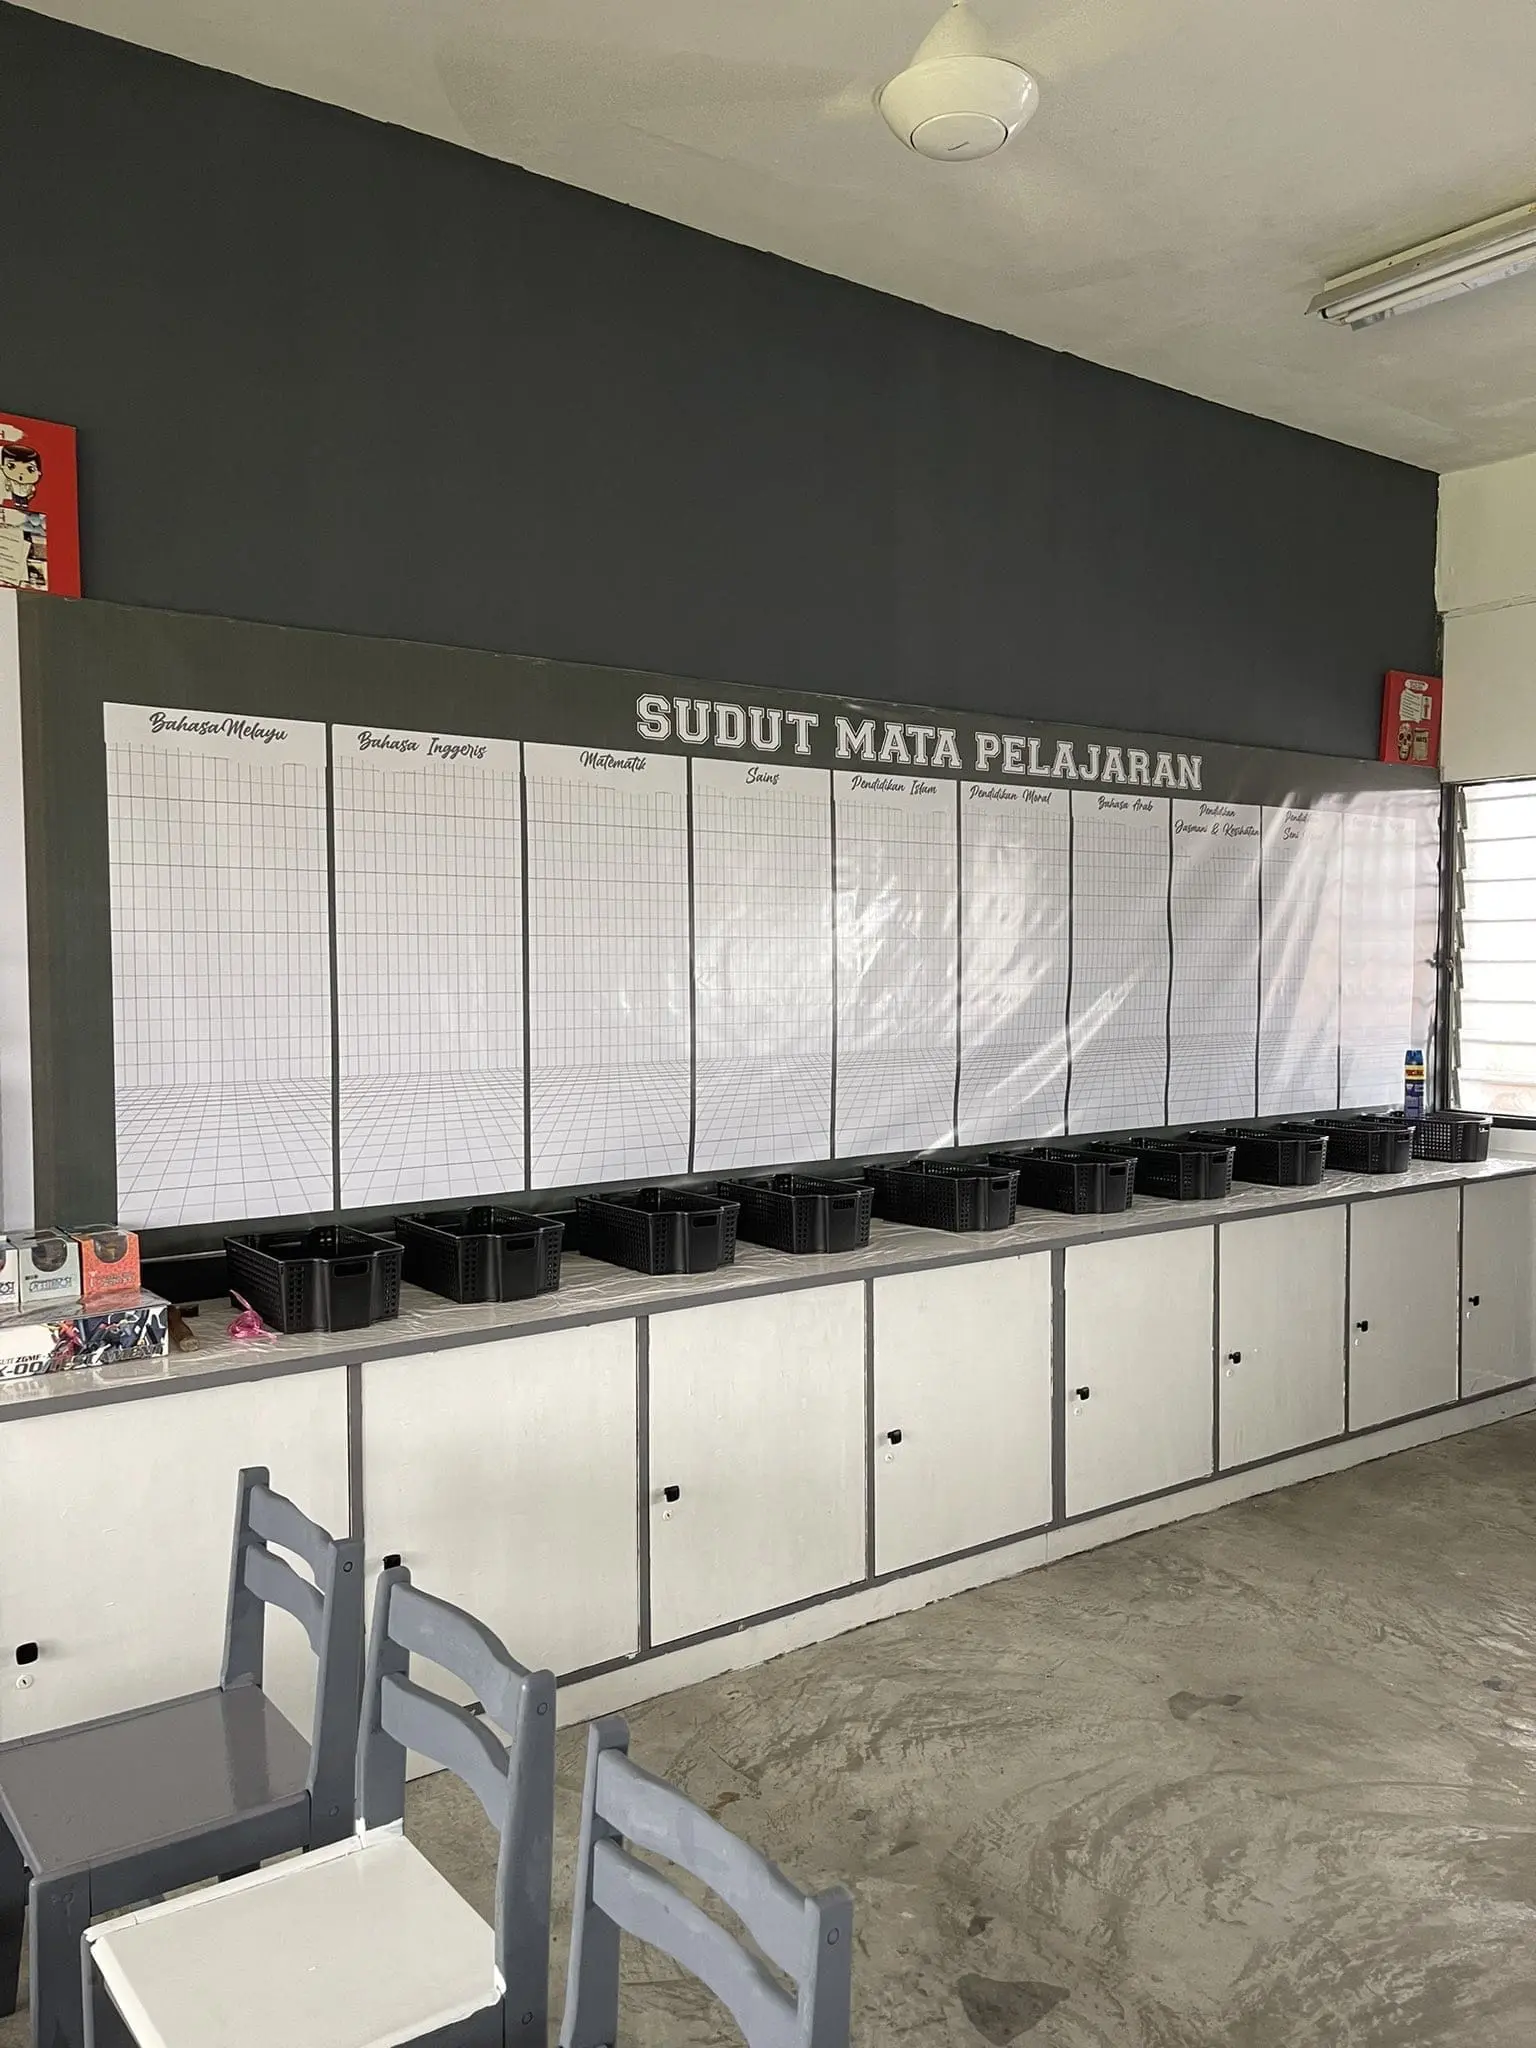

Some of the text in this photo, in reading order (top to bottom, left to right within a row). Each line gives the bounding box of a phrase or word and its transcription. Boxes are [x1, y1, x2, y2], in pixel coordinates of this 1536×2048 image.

[149, 711, 289, 744] Bahasa Melayu
[357, 730, 488, 760] Bahasa Inggeris
[636, 693, 1202, 791] SUDUT MATA PELAJARAN
[579, 750, 647, 772] Matematik
[745, 766, 780, 785] Sains
[851, 775, 938, 796] Pendidikan Islam
[969, 784, 1053, 805] Pendidikan Moral
[1097, 795, 1154, 813] Bahasa Arab
[1211, 822, 1220, 836] &
